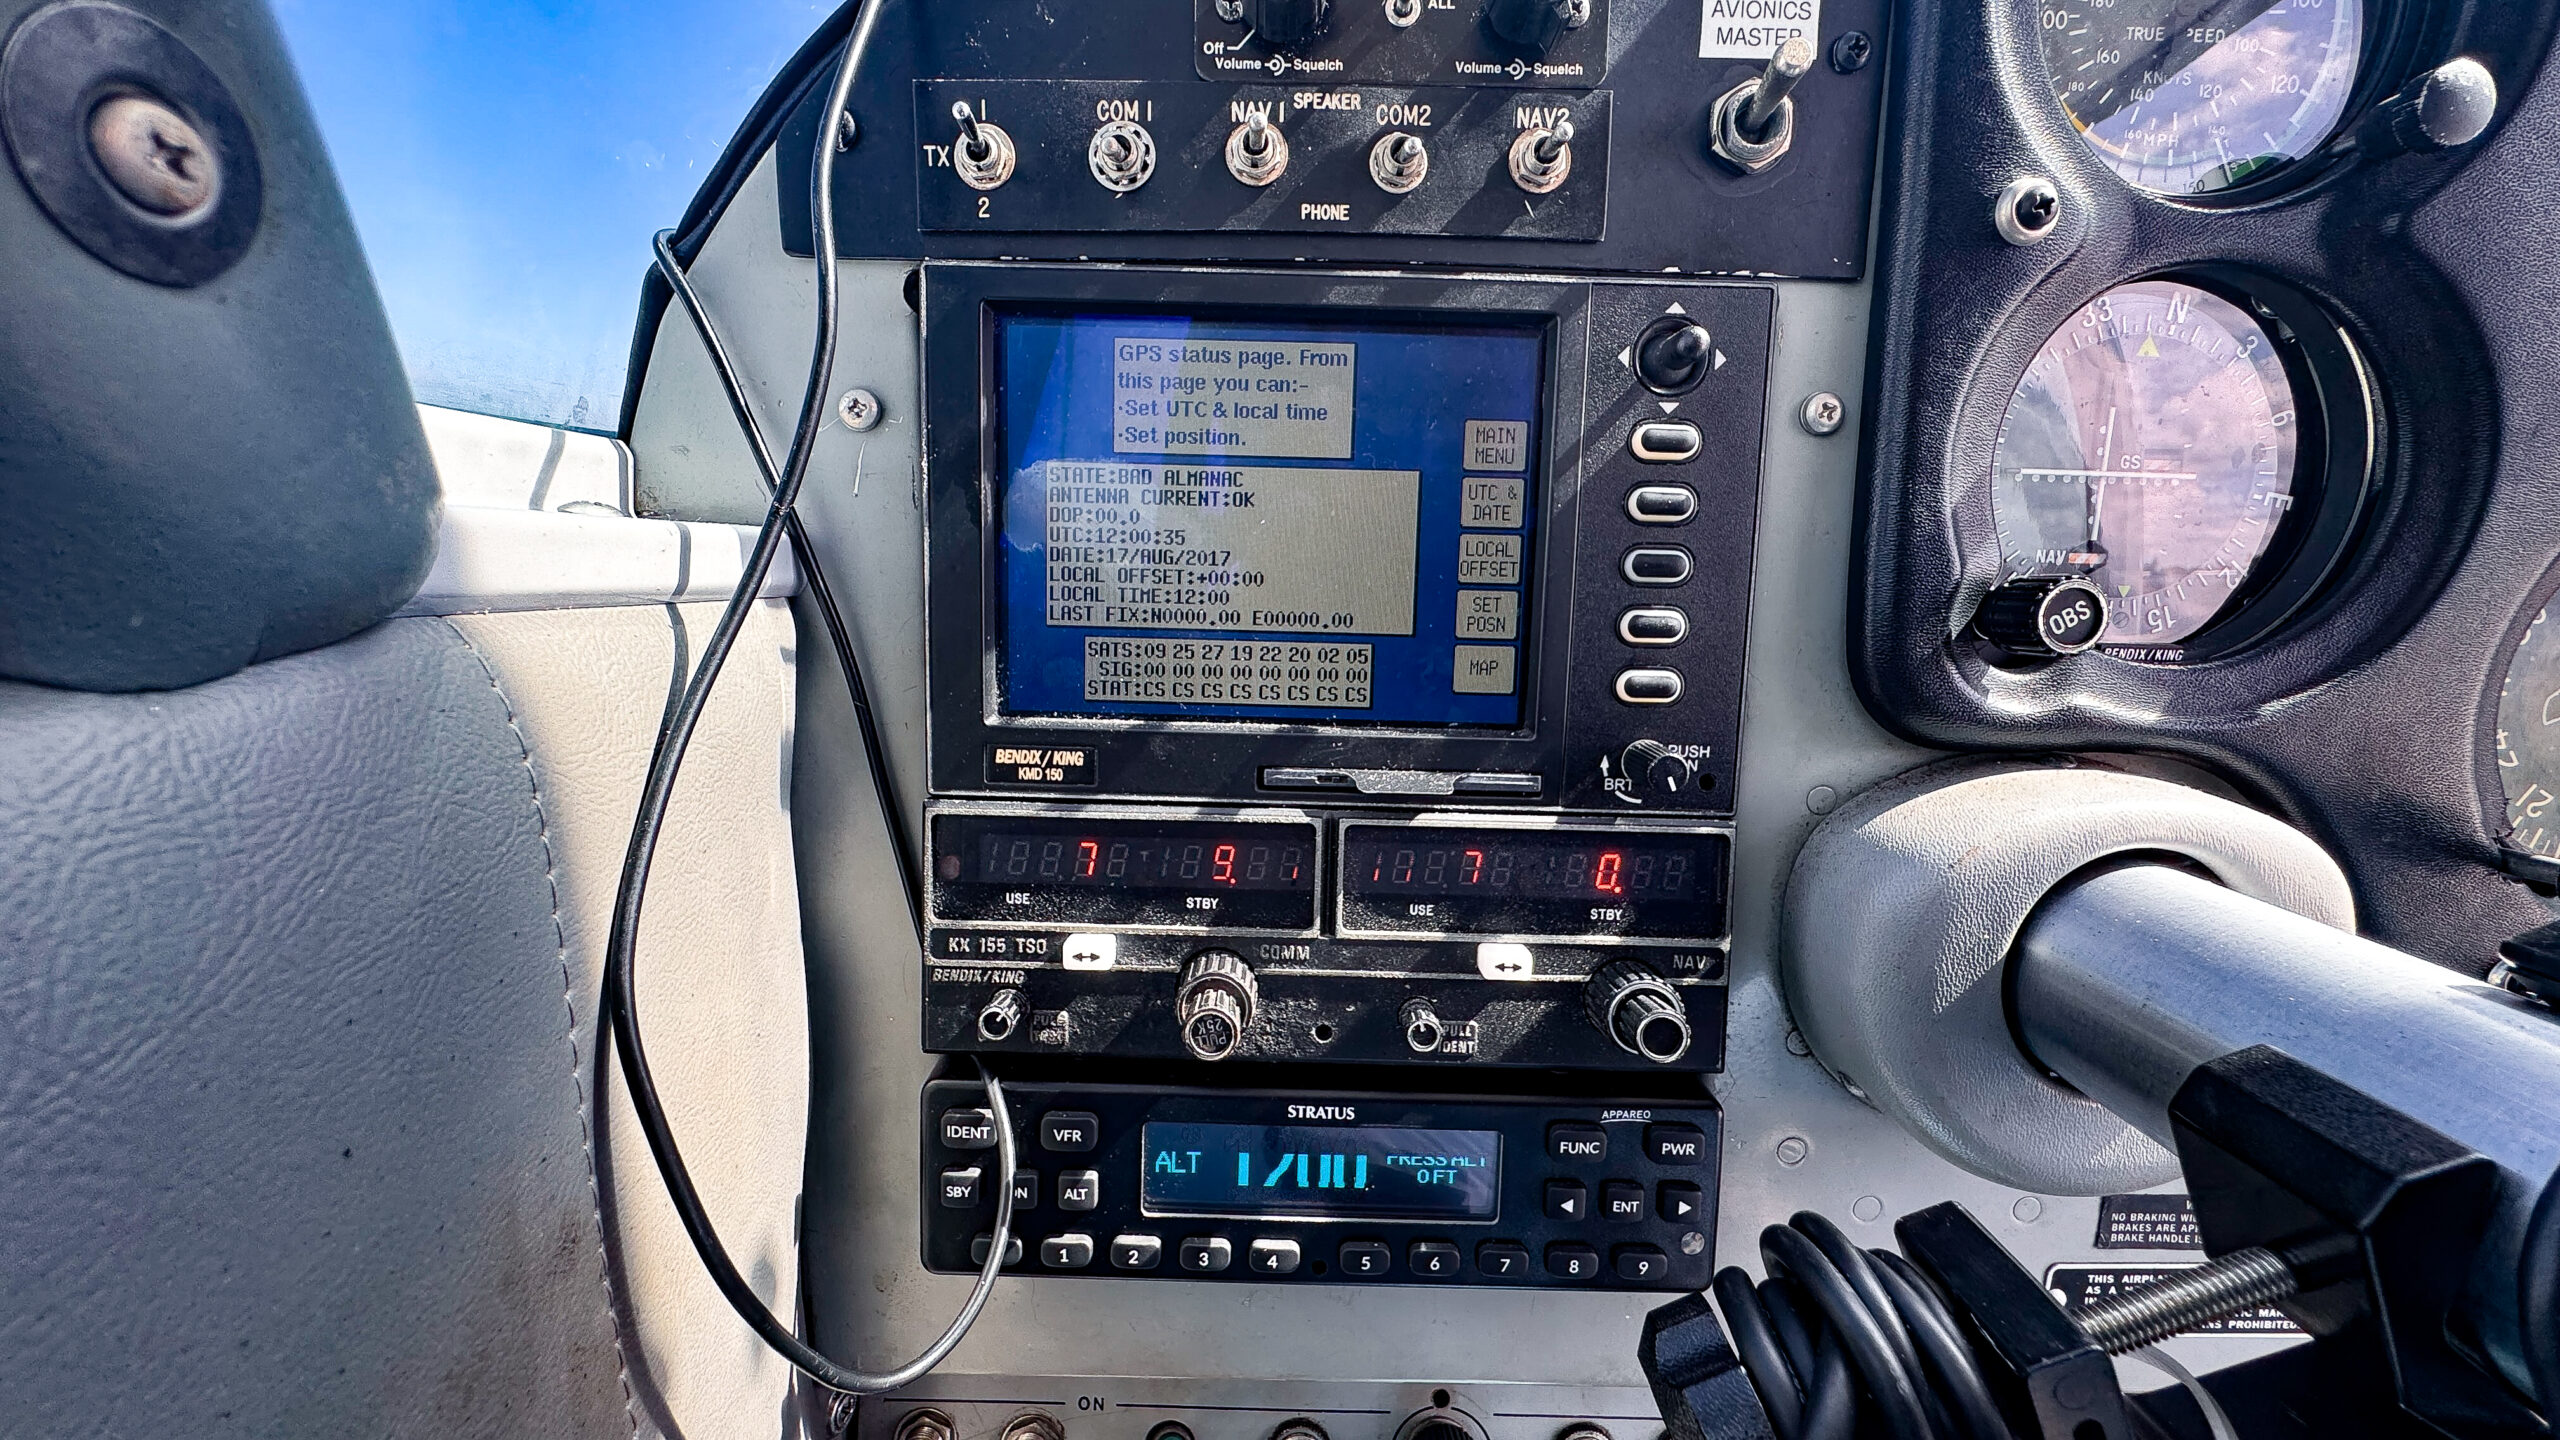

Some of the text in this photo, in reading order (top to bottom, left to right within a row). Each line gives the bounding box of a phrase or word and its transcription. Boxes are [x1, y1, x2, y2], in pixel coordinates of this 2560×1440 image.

[1427, 0, 1456, 9] ALL
[1711, 0, 1812, 20] AVIONICS
[2041, 10, 2068, 30] 00
[2126, 26, 2165, 42] TRUE
[1203, 41, 1225, 55] Off
[1215, 57, 1344, 73] Volume Squelch
[2096, 50, 2120, 64] 160
[1455, 61, 1583, 77] Volume Squelch
[2068, 82, 2085, 92] 180
[2200, 85, 2223, 99] 120
[2270, 74, 2300, 94] 120
[1293, 92, 1361, 111] SPEAKER
[2130, 88, 2154, 103] 140
[1097, 100, 1139, 122] COM
[1231, 101, 1272, 123] NAV
[1376, 104, 1432, 126] COM2
[2124, 129, 2180, 148] 160 MPH
[922, 144, 950, 167] TX
[978, 197, 990, 218] 2
[1301, 203, 1350, 221] PHONE
[2082, 296, 2113, 328] 33
[2166, 291, 2192, 324] N
[2236, 335, 2259, 359] 3
[1119, 344, 1348, 370] GPS status page. From
[1117, 372, 1152, 389] this
[1160, 376, 1206, 395] page
[1213, 378, 1249, 396] you
[1166, 400, 1207, 418] UTC
[1212, 402, 1228, 418] &
[1234, 402, 1278, 420] local
[1286, 403, 1328, 421] time
[2271, 409, 2296, 428] 6
[1164, 428, 1246, 448] position.
[1475, 427, 1516, 444] MAIN
[1475, 447, 1514, 464] MENU
[2120, 455, 2141, 469] GS
[1049, 466, 1244, 487] STATE:BAD ALMANAC
[1050, 486, 1255, 508] ANTENNA CURRENT:OK
[1468, 484, 1517, 501] UTC &
[2264, 491, 2294, 511] E
[1050, 506, 1141, 525] DOP:00.0
[1472, 504, 1512, 521] DATE
[1050, 526, 1186, 546] UTC:12:00:35
[1050, 546, 1231, 567] DATE:17/AUG/2017
[1465, 541, 1514, 558] LOCAL
[2035, 550, 2067, 566] NAV
[1050, 566, 1264, 587] LOCAL OFFSET:+00:00
[1460, 560, 1518, 577] OFFSET
[2219, 560, 2248, 590] 12
[1050, 586, 1230, 605] LOCAL TIME:12:00
[1472, 596, 1502, 613] SET
[1050, 605, 1354, 629] LAST FIX:N0000.00 E00000.00
[1466, 616, 1506, 633] POSN
[2049, 600, 2091, 635] OBS
[2147, 605, 2177, 633] 15
[1087, 641, 1368, 664] SATS:09 25 27 19 22 20 02 05
[2105, 647, 2184, 662] BENDIX/KING
[1099, 661, 1368, 683] SIG:00 00 00 00 00 00 00 00
[1469, 659, 1499, 676] MAP
[1087, 680, 1367, 703] STAT:CS CS CS CS CS CS CS CS
[995, 748, 1085, 768] BENDIX/KING
[1668, 744, 1711, 759] PUSH
[1018, 766, 1064, 781] KMD 150
[1604, 778, 1632, 792] BRT
[1006, 892, 1030, 905] USE
[1186, 896, 1219, 910] STBY
[1410, 903, 1434, 916] USE
[1590, 908, 1623, 922] STBY
[948, 937, 1047, 954] KX 155 TSO
[1259, 944, 1310, 960] COMM
[1673, 955, 1706, 969] NAV
[932, 968, 1026, 984] BENDIX/KING
[1287, 1104, 1355, 1120] STRATUS
[1601, 1110, 1651, 1119] APPAREO
[946, 1125, 991, 1139] IDENT
[1053, 1129, 1082, 1142] VFR
[1560, 1141, 1600, 1154] FUNC
[1661, 1143, 1695, 1156] PWR
[1155, 1151, 1201, 1174] ALT
[946, 1186, 972, 1198] SBY
[1064, 1188, 1088, 1200] ALT
[1612, 1201, 1640, 1213] ENT
[2111, 1213, 2176, 1222] NO BRAKING
[2111, 1223, 2152, 1232] BRAKES
[2156, 1224, 2176, 1232] ARE
[2110, 1233, 2190, 1243] BRAKE HANDLE
[1059, 1248, 1069, 1262] 1
[1128, 1250, 1139, 1264] 2
[1198, 1252, 1209, 1266] 3
[1266, 1254, 1278, 1269] 4
[1361, 1256, 1371, 1270] 5
[1429, 1257, 1440, 1271] 6
[1500, 1259, 1511, 1273] 7
[1569, 1260, 1579, 1274] 8
[1638, 1261, 1649, 1275] 9
[2087, 1274, 2115, 1283] THIS
[2085, 1286, 2101, 1294] AS
[2108, 1286, 2117, 1294] A
[1078, 1396, 1106, 1411] ON
